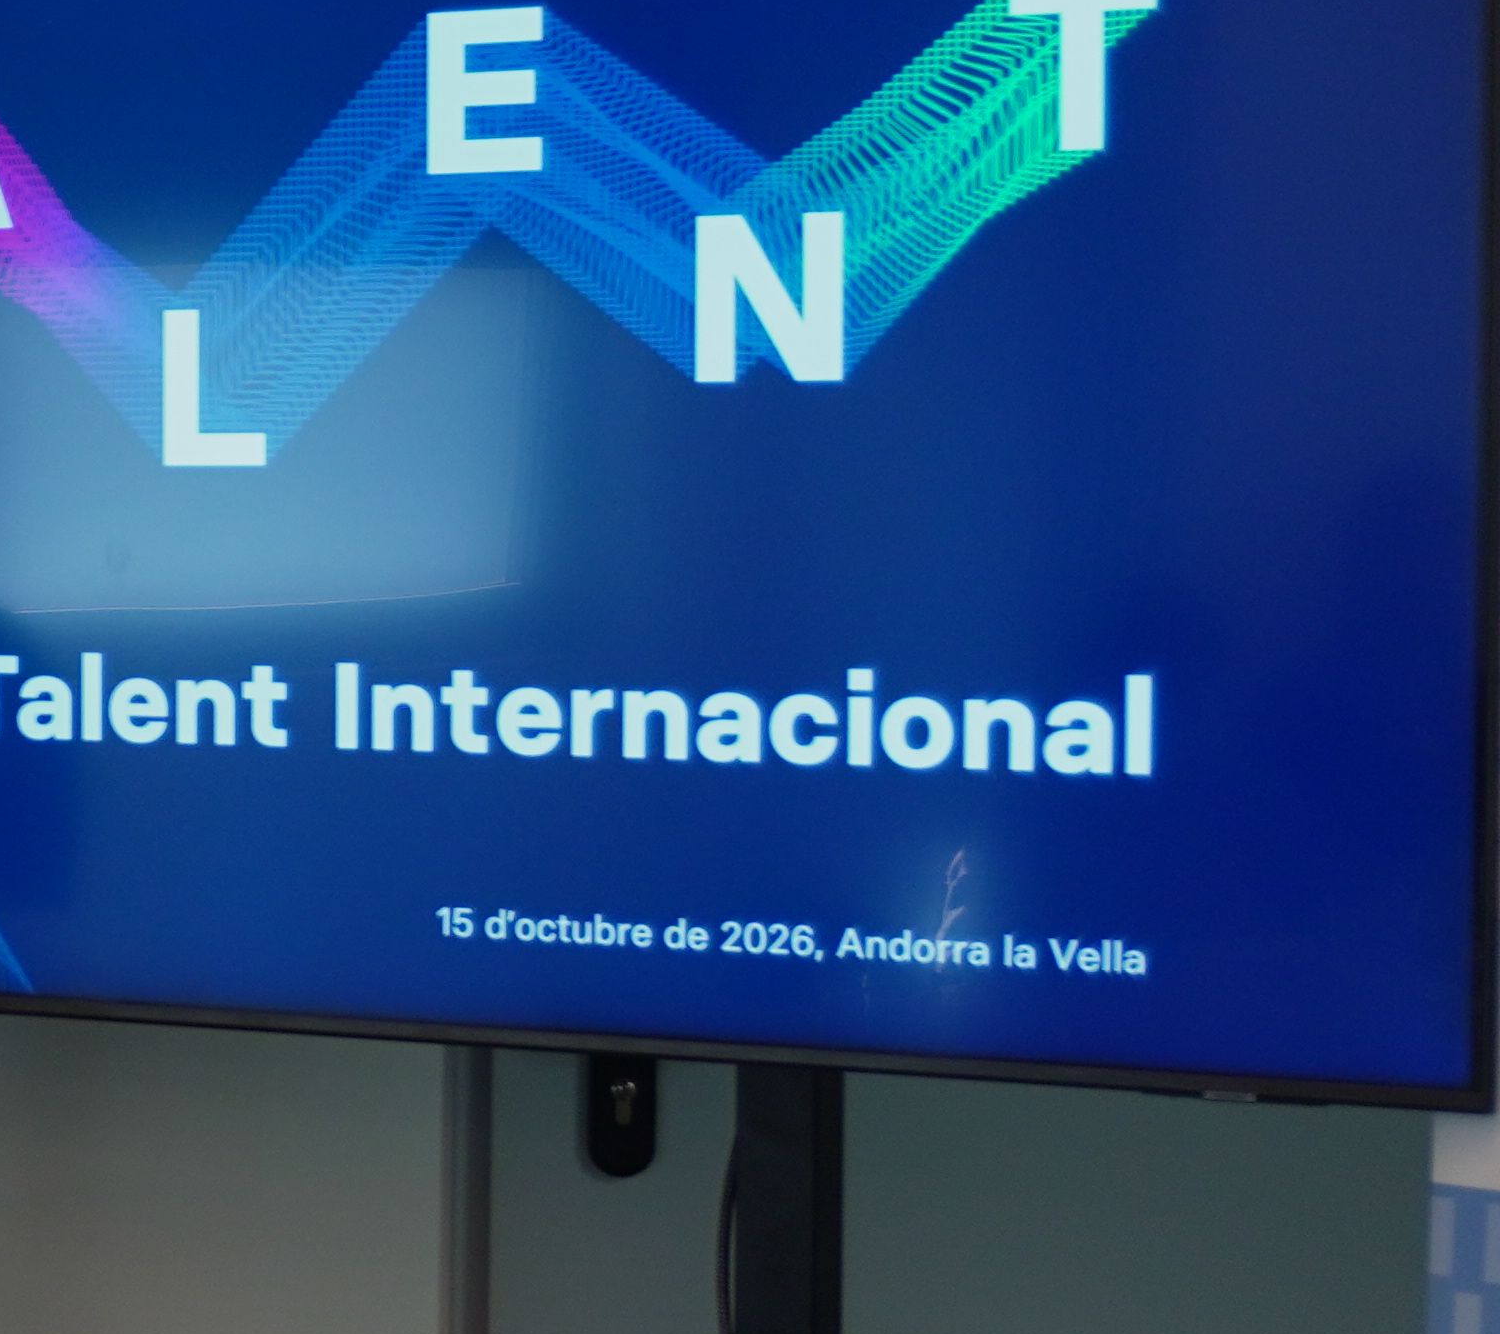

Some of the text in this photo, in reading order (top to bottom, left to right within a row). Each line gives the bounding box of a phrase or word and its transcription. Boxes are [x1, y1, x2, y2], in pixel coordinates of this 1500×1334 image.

[335, 662, 1153, 775] Internacional
[436, 906, 1146, 975] 15 d'octubre de 2026, Andorra la Vella
